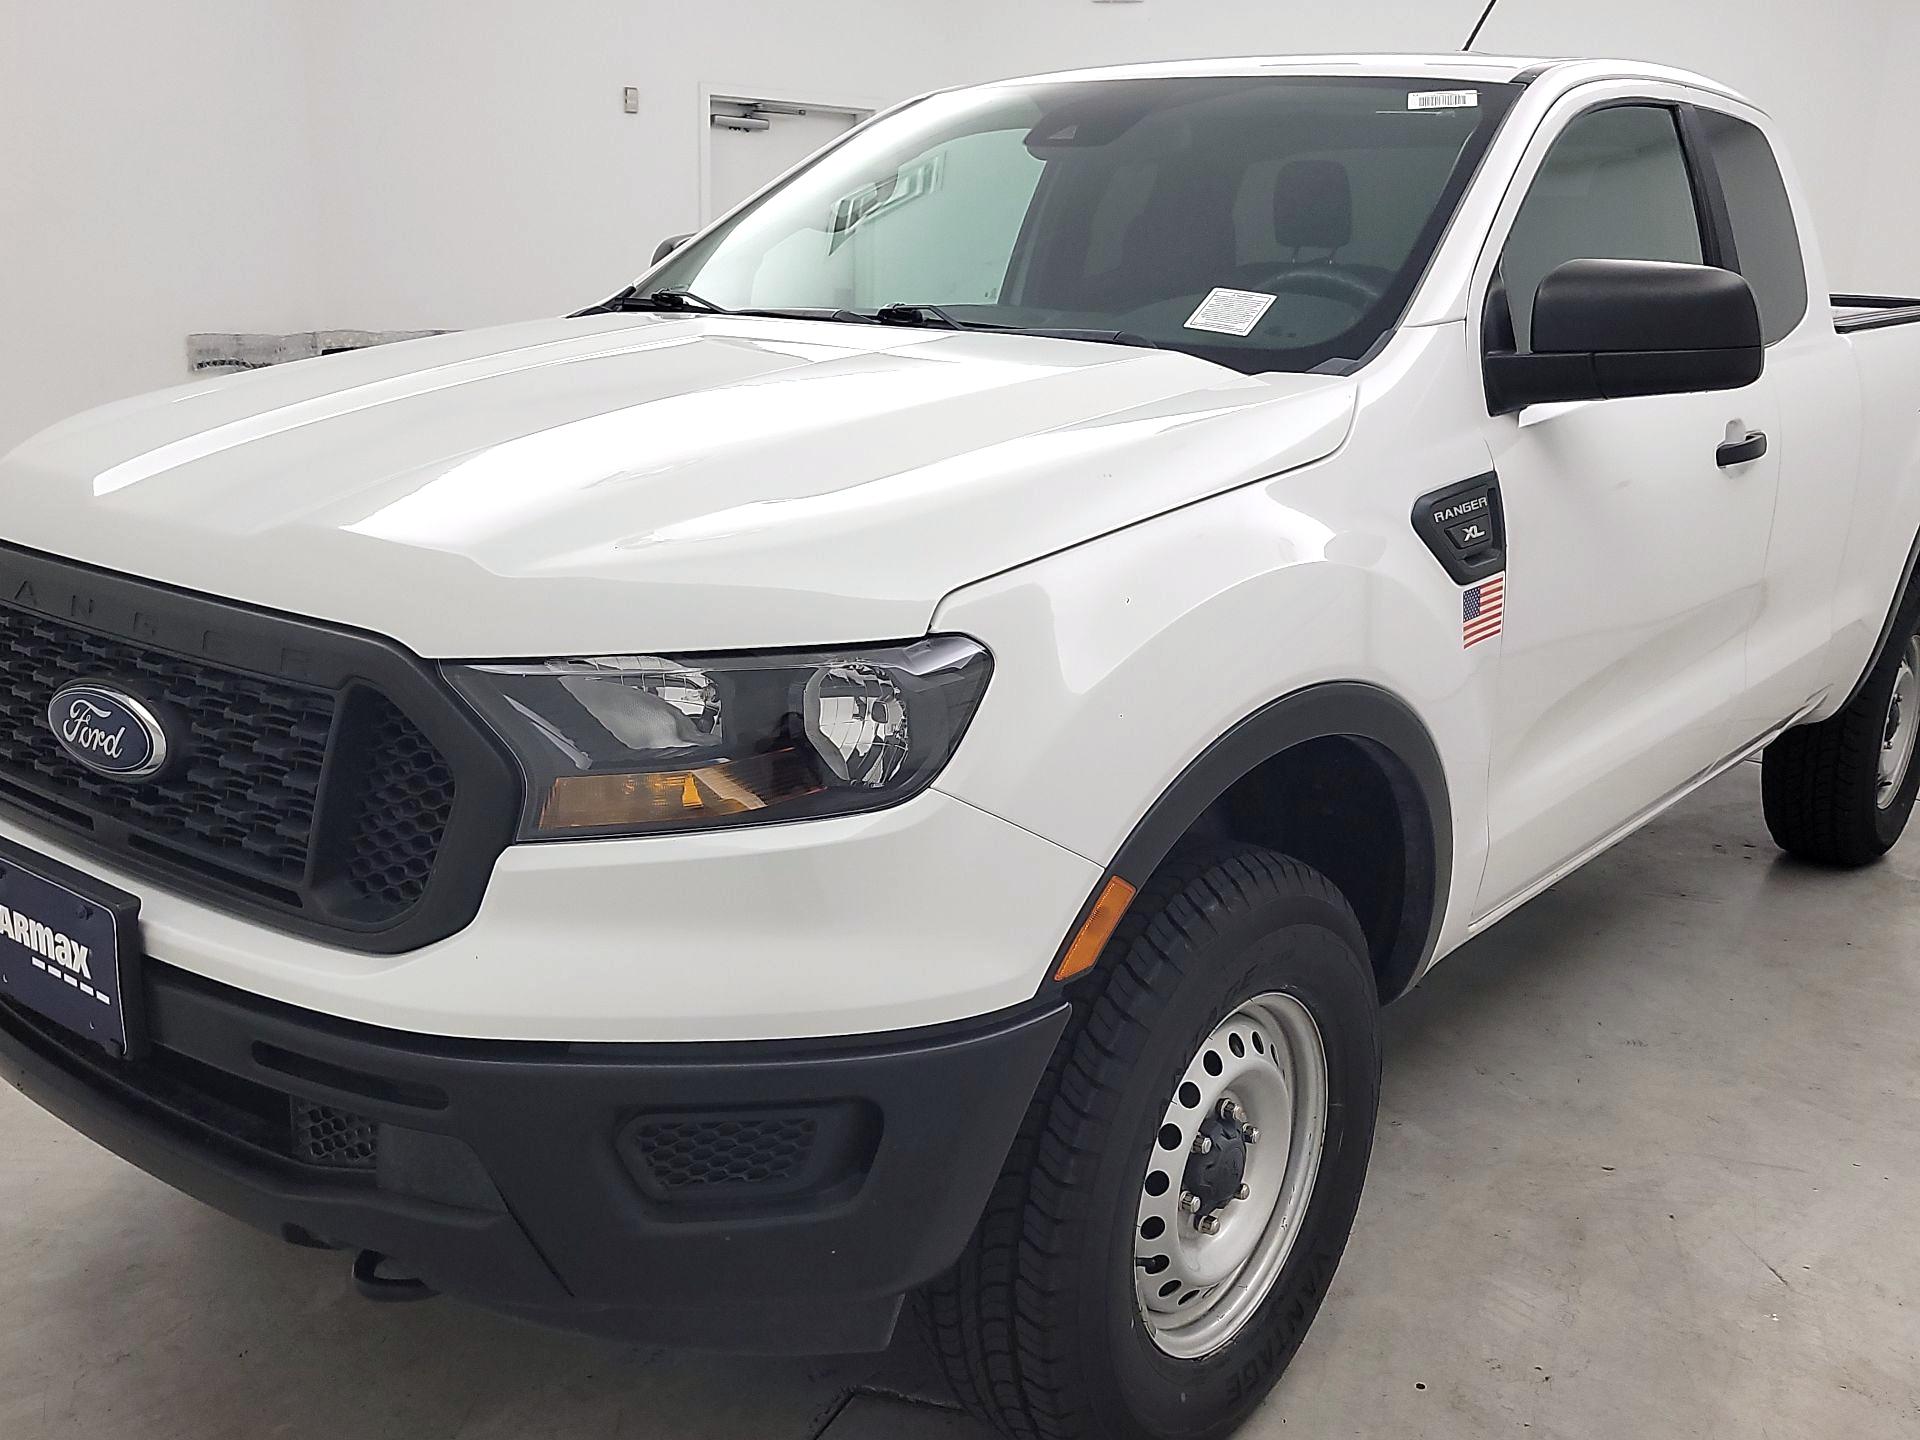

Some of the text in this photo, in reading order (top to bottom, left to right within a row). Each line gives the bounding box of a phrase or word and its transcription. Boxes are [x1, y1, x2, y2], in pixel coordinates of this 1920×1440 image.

[1433, 496, 1488, 523] RANGER
[1461, 524, 1485, 542] XL
[62, 699, 126, 759] Ford
